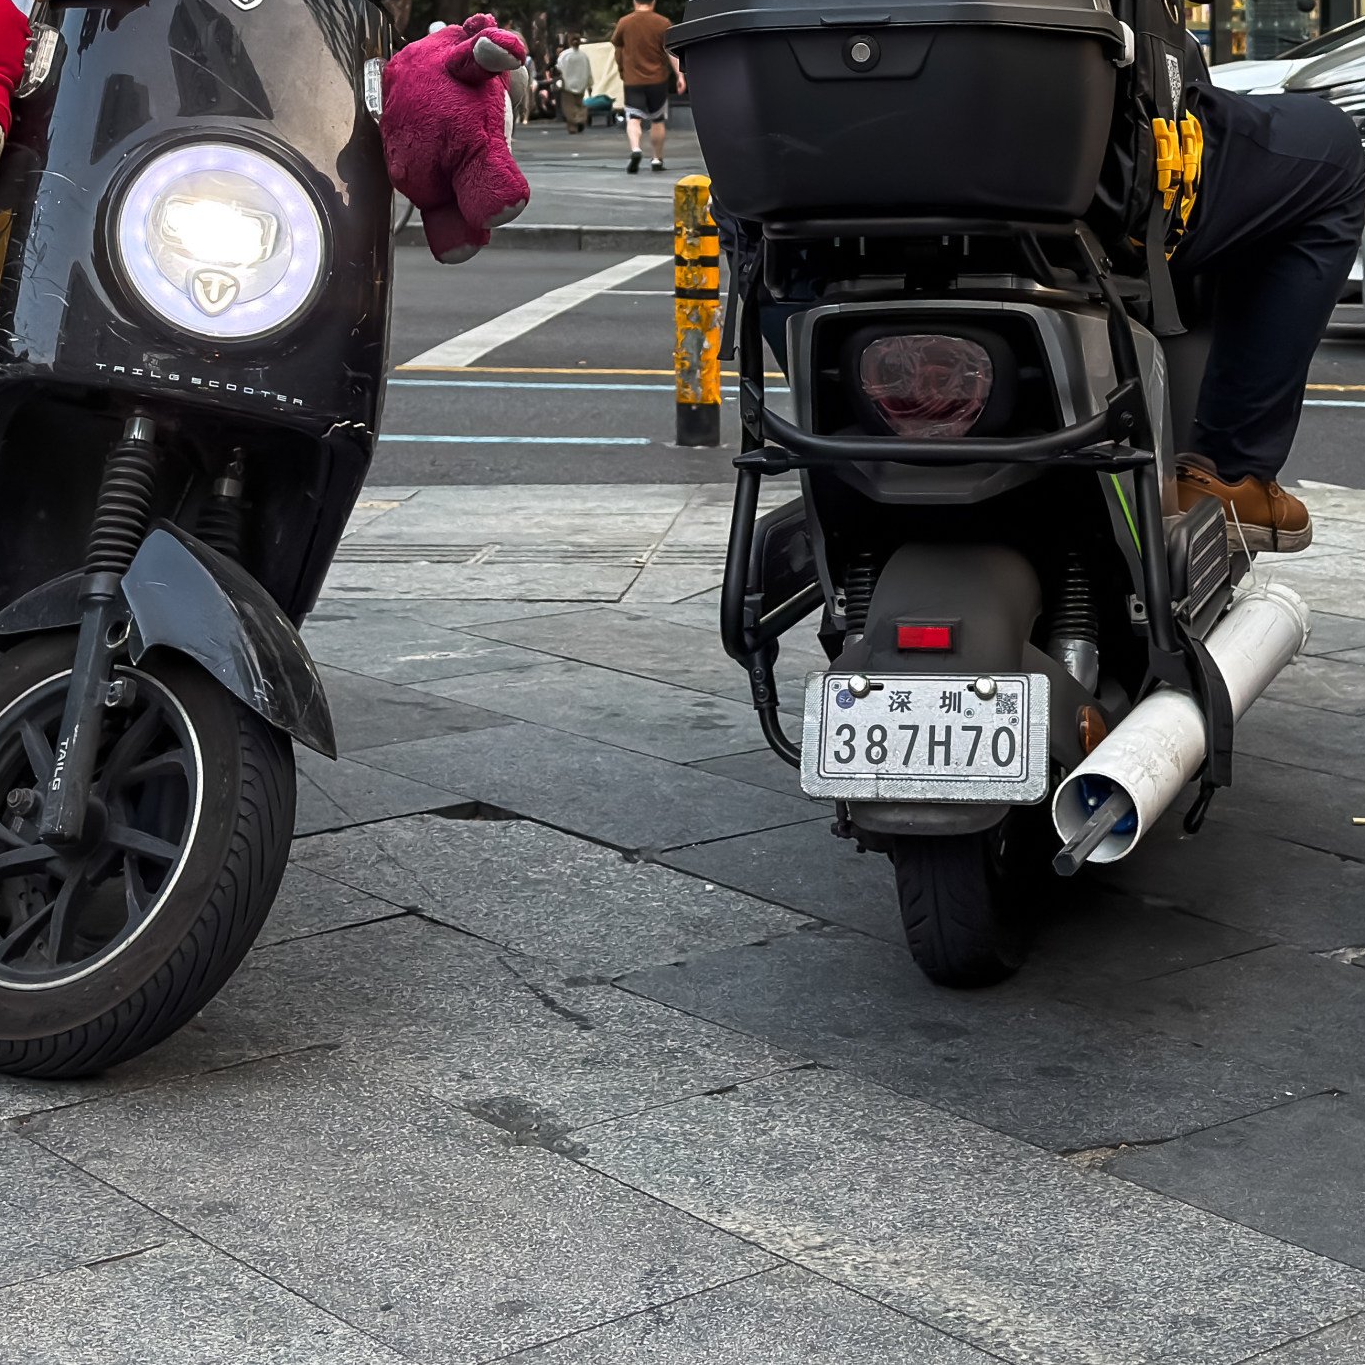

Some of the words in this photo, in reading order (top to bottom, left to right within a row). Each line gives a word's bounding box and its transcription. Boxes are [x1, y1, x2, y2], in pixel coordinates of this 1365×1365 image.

[95, 363, 179, 381] TAILG
[191, 377, 304, 407] SCOOTER
[888, 690, 962, 714] 深圳
[52, 737, 69, 791] TAILG
[833, 723, 1016, 768] 387H70
